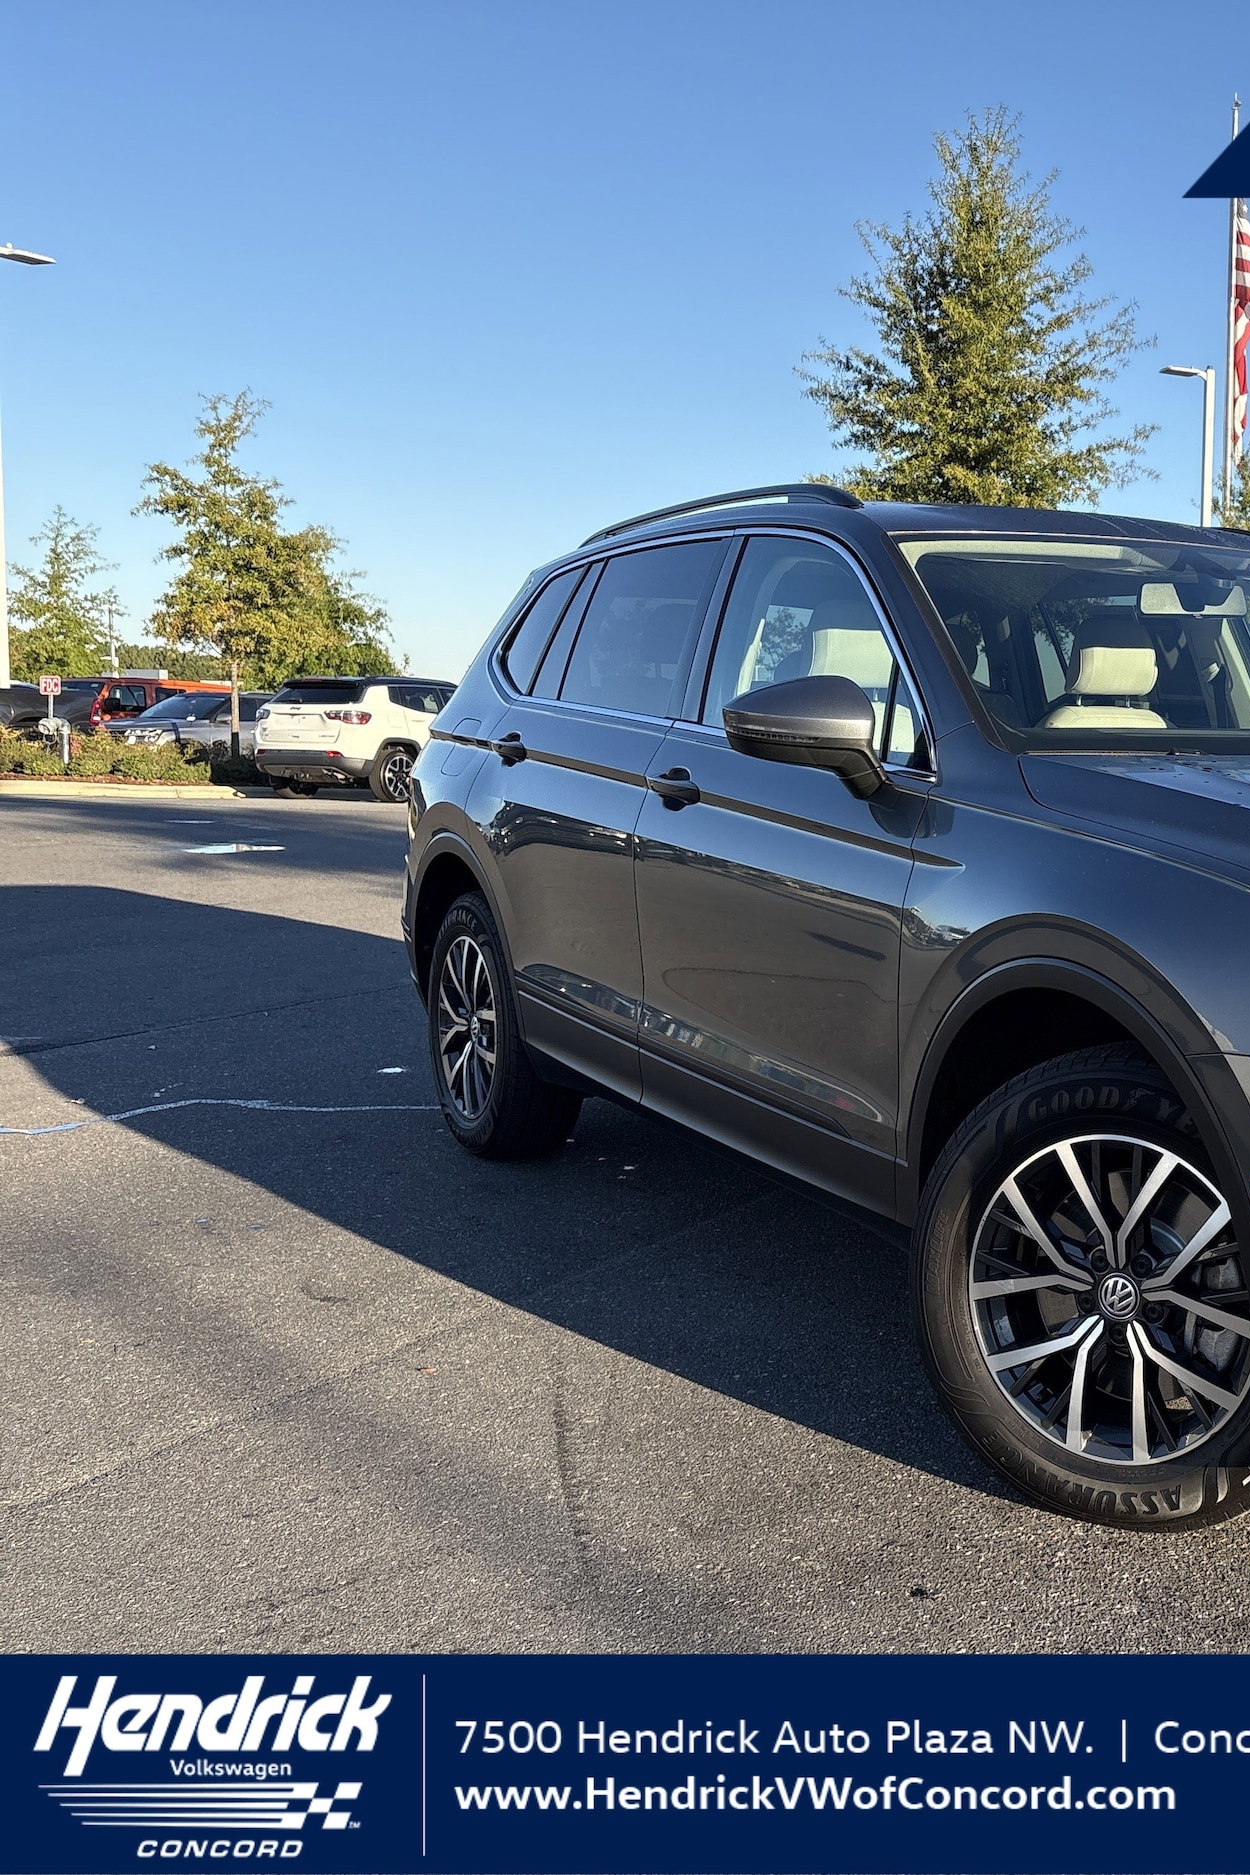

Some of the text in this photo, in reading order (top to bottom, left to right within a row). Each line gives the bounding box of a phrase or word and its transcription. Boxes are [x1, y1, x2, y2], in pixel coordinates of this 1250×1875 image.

[41, 678, 59, 692] FDC
[1027, 1085, 1121, 1122] GOOD
[981, 1429, 1183, 1516] ASSURANCE
